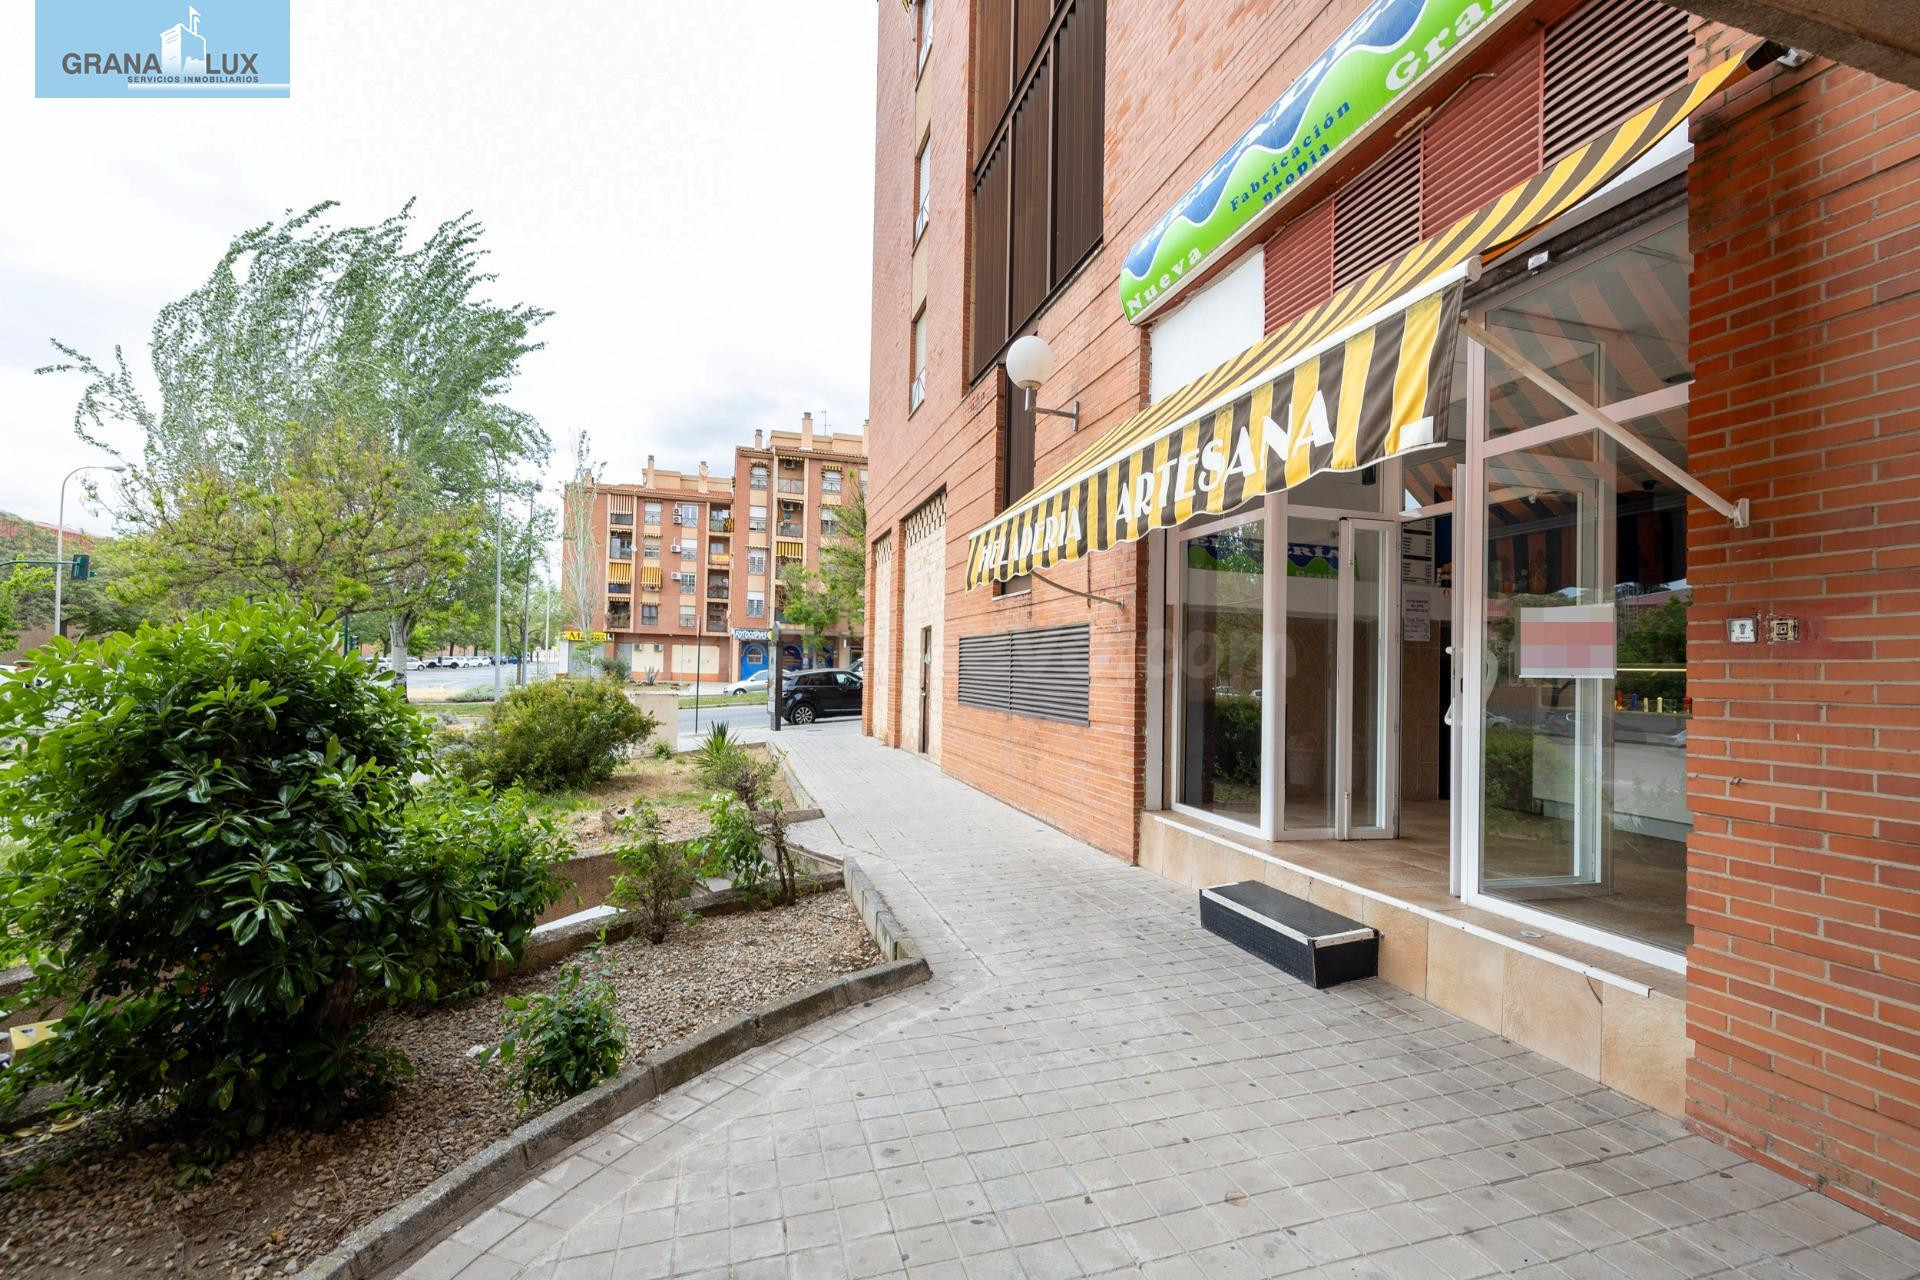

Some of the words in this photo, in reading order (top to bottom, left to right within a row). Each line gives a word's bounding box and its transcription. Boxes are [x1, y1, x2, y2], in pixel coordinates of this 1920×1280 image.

[1229, 101, 1351, 213] Fabricación
[1262, 142, 1331, 204] propia
[1126, 247, 1202, 317] Nueva
[978, 506, 1082, 573] HELADERIA
[1114, 389, 1335, 527] ARTESANA
